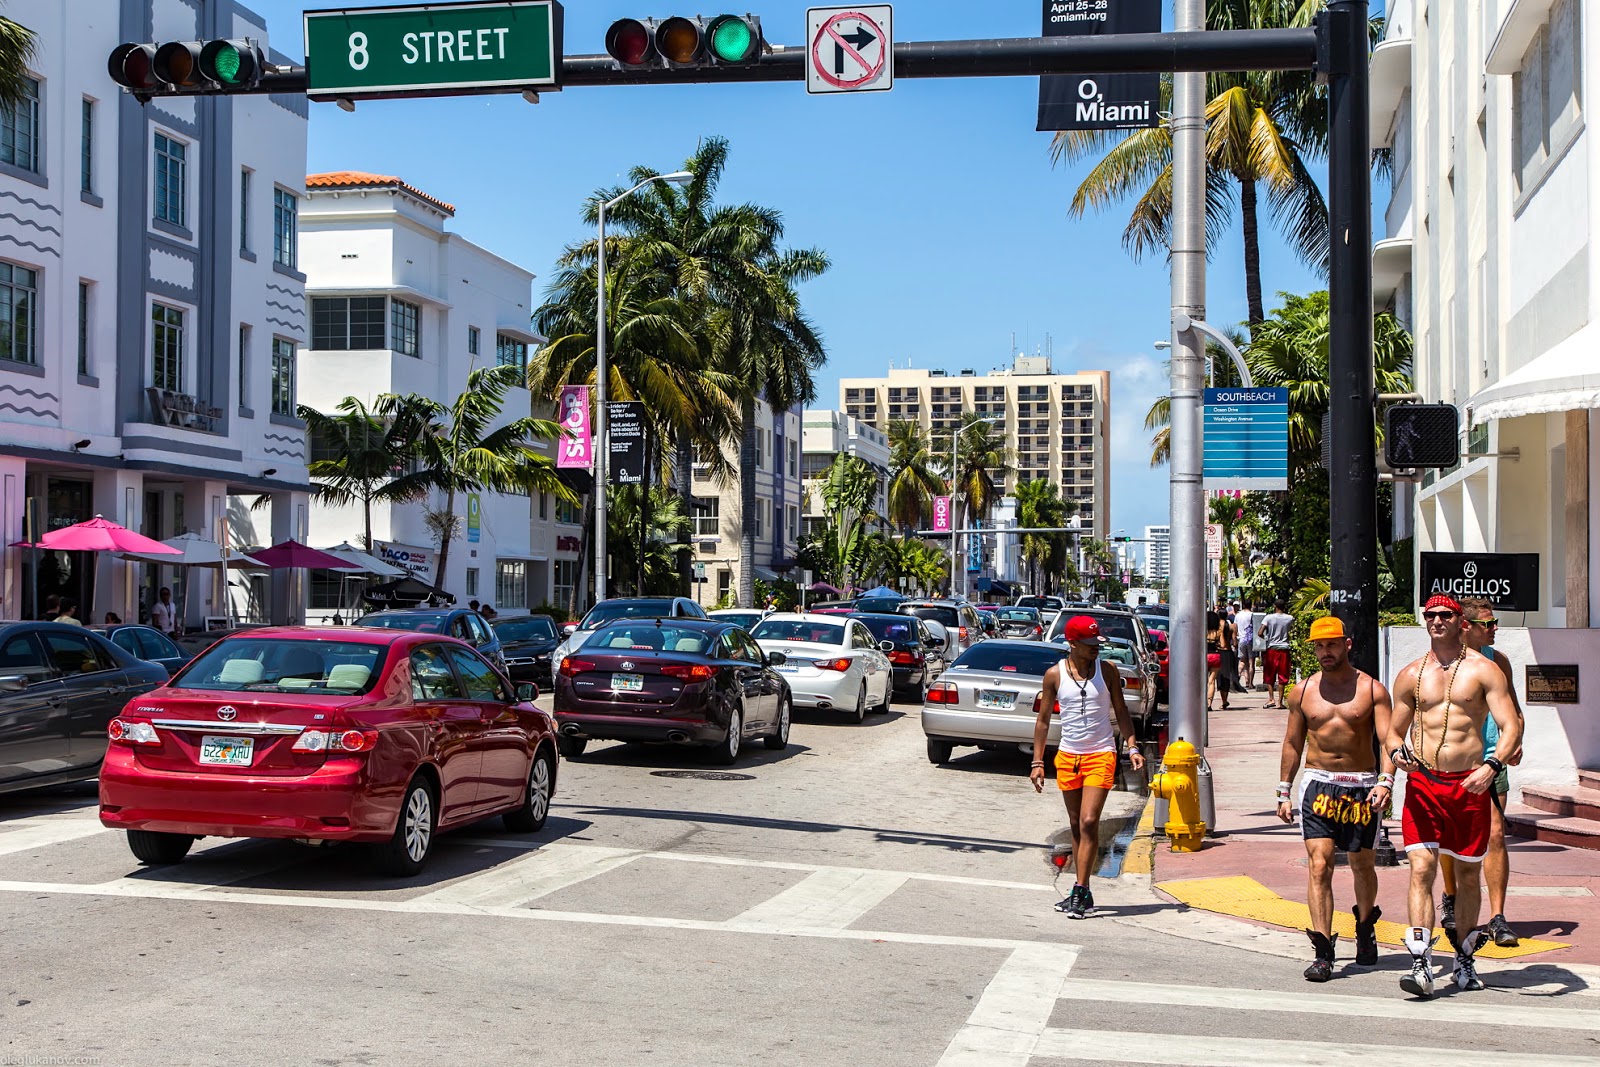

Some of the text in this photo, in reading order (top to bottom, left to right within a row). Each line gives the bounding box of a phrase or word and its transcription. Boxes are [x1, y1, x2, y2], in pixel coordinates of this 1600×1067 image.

[1051, 3, 1074, 13] April
[1051, 11, 1107, 22] omiami.org
[348, 28, 509, 71] 8 STREET
[1078, 79, 1103, 102] O,
[1075, 100, 1150, 121] Miami
[565, 393, 585, 458] SHOP
[619, 468, 629, 476] O,
[619, 474, 642, 482] Miami
[937, 499, 946, 528] SHOP
[380, 548, 409, 561] TACO
[409, 564, 429, 573] LUNCH
[1431, 578, 1511, 595] AUGELLO'S
[204, 744, 221, 759] 622
